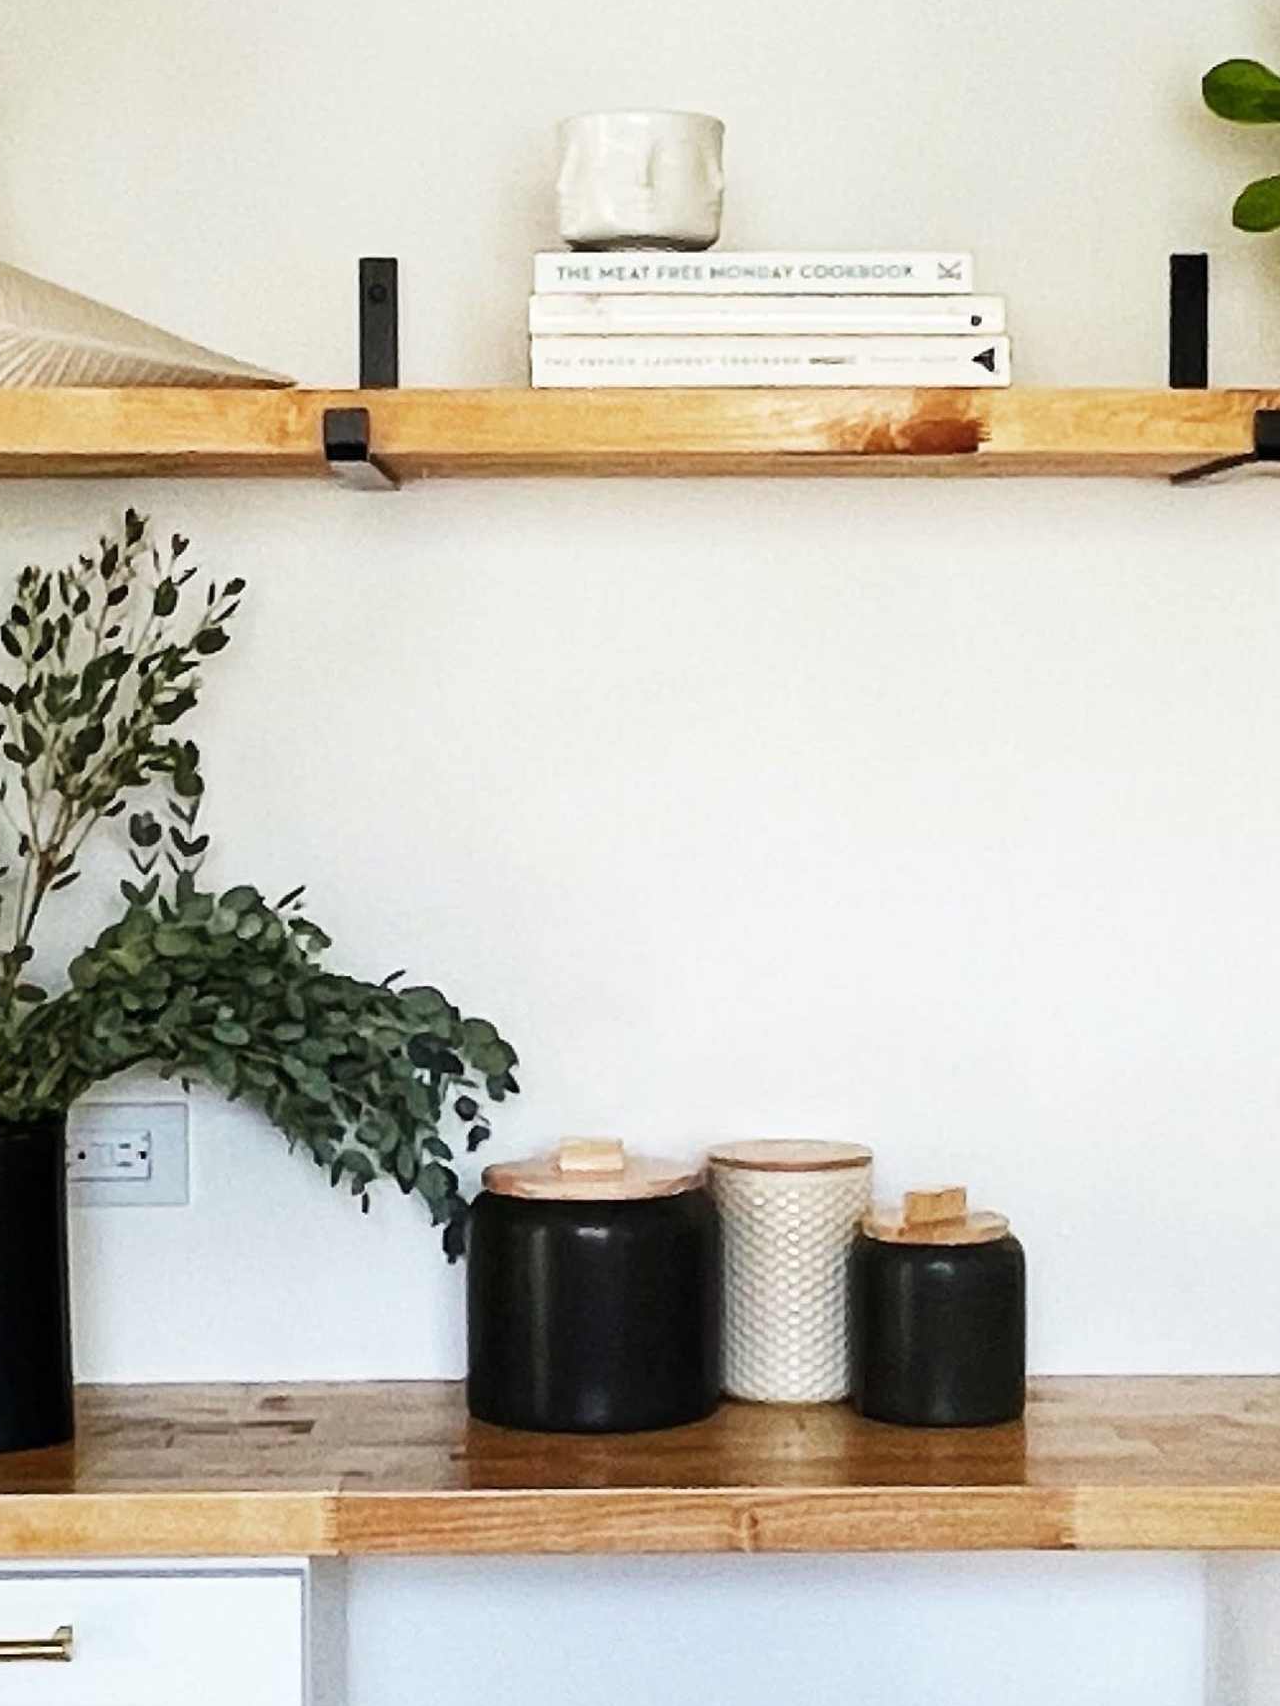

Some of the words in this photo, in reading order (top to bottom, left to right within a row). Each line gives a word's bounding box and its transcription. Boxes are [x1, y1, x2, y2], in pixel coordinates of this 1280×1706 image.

[556, 265, 592, 282] THE
[598, 265, 651, 282] MEAT
[656, 265, 704, 282] FREE
[709, 265, 794, 281] MONDAY
[799, 264, 914, 281] COOKBOOK
